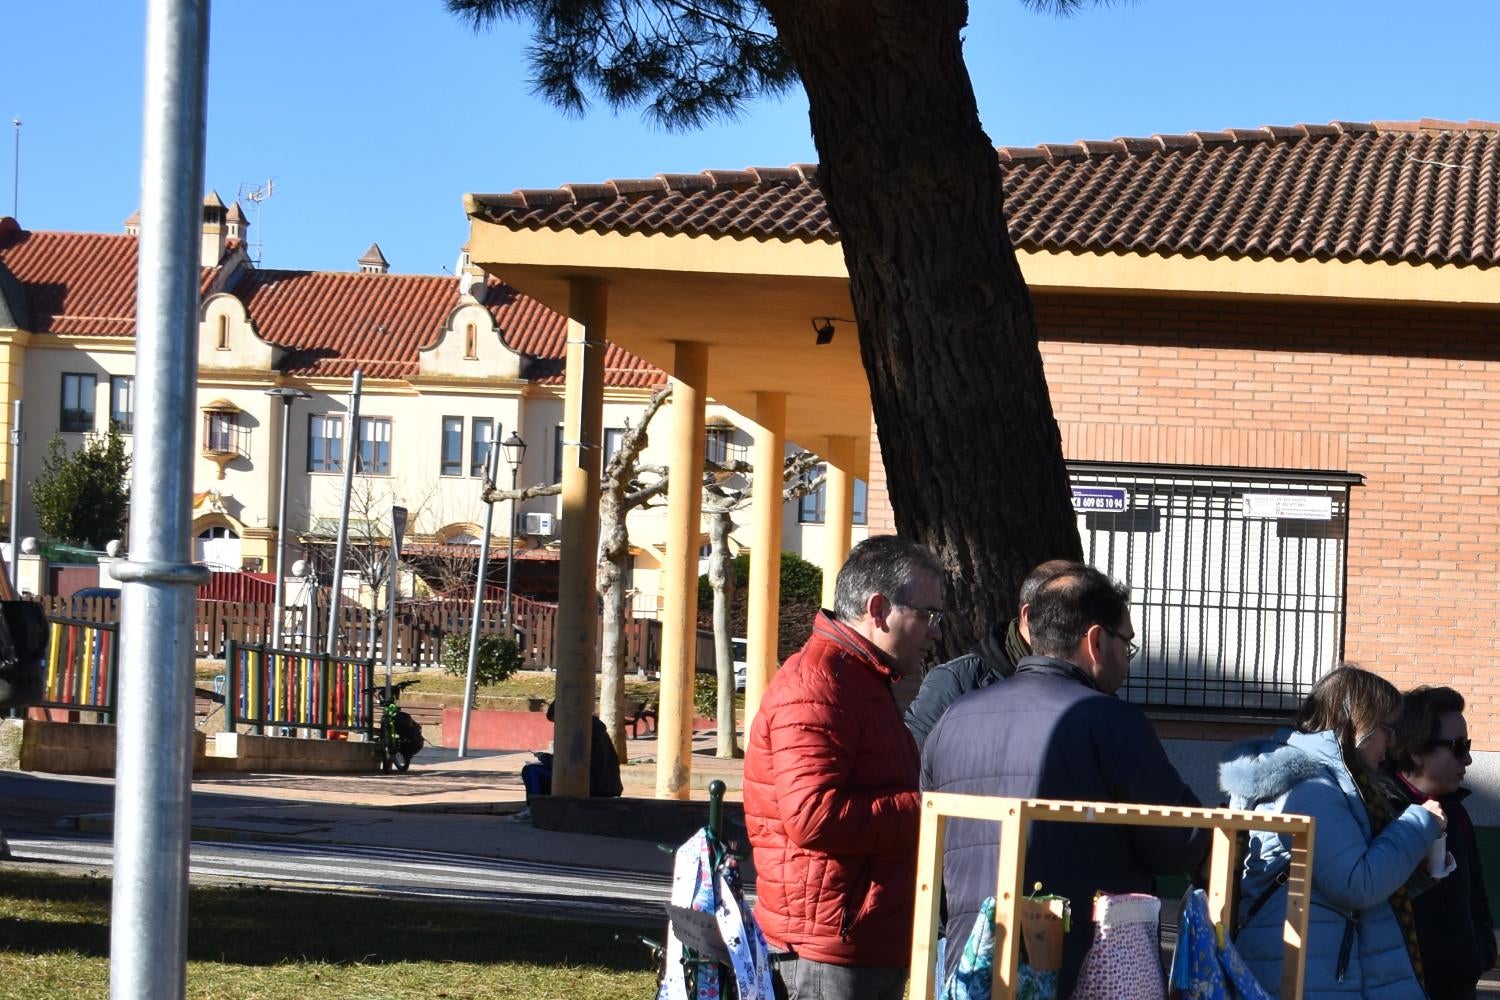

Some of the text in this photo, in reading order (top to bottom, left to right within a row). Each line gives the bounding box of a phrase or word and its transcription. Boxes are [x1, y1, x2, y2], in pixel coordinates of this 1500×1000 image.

[1083, 497, 1095, 507] 609
[1096, 497, 1104, 508] 05
[1106, 498, 1114, 508] 10
[1114, 498, 1123, 508] 94
